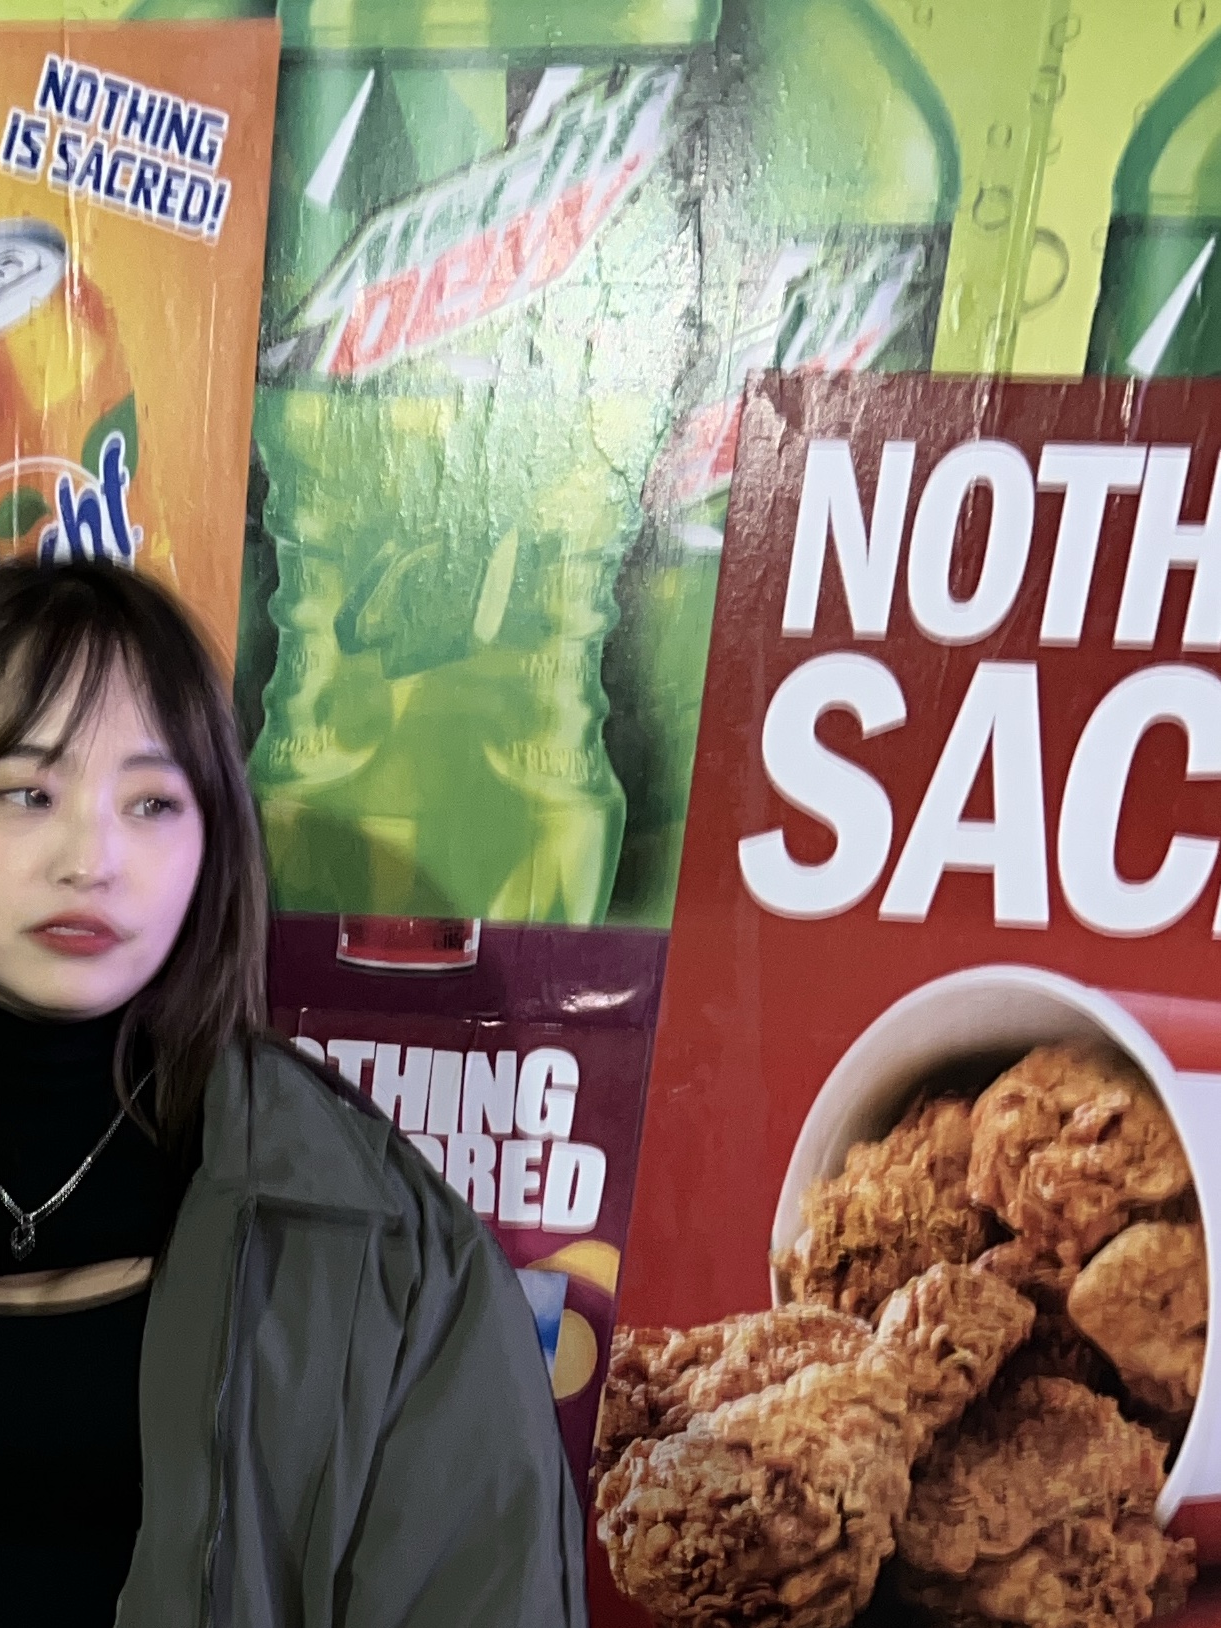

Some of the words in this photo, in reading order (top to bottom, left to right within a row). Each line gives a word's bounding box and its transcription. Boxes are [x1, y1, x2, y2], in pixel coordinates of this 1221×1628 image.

[35, 53, 229, 170] NOTHING
[48, 126, 232, 246] SACRED!
[782, 439, 1221, 652] NOTH
[738, 652, 1221, 938] SAC
[289, 1036, 579, 1142] THING
